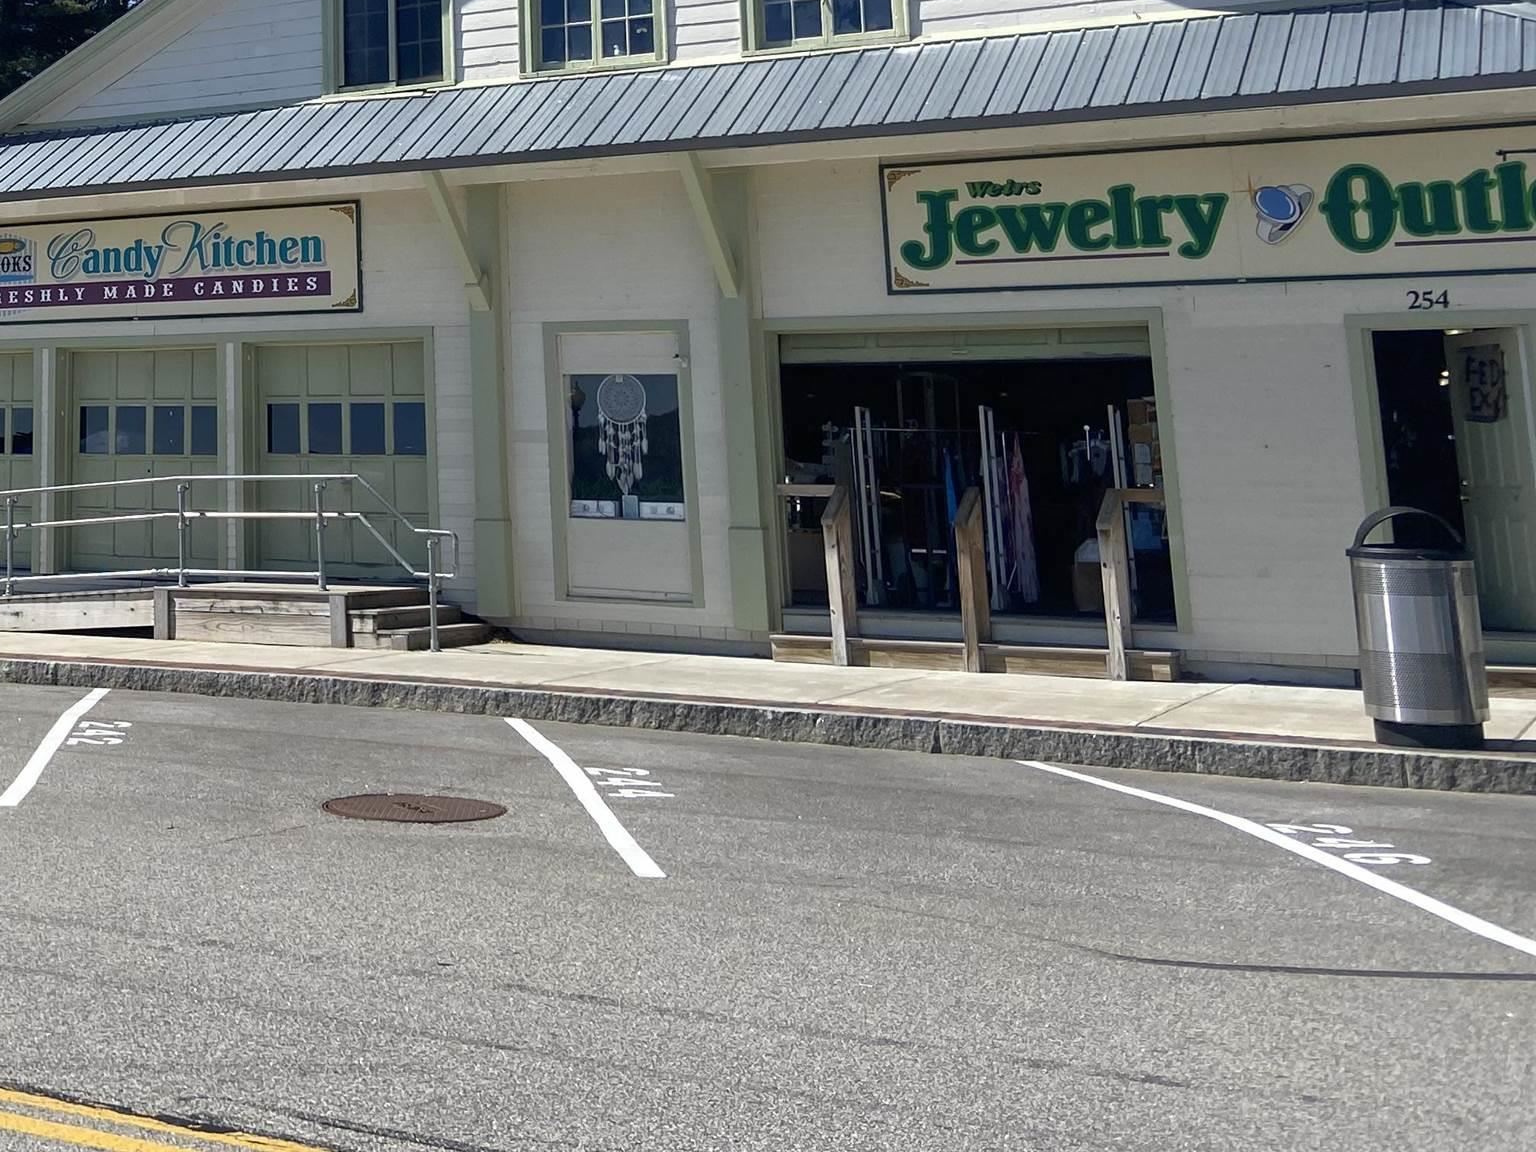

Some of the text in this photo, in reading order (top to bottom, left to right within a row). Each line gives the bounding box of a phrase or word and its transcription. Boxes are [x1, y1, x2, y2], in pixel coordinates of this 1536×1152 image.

[966, 179, 1042, 198] Weirs
[900, 183, 1229, 270] Jewelry
[47, 220, 323, 279] Candy Kitchen
[103, 281, 173, 300] MADE
[193, 276, 318, 296] CANDIES
[1406, 289, 1449, 309] 254
[66, 720, 133, 745] 242
[583, 766, 676, 798] 244
[1265, 823, 1432, 865] 246
